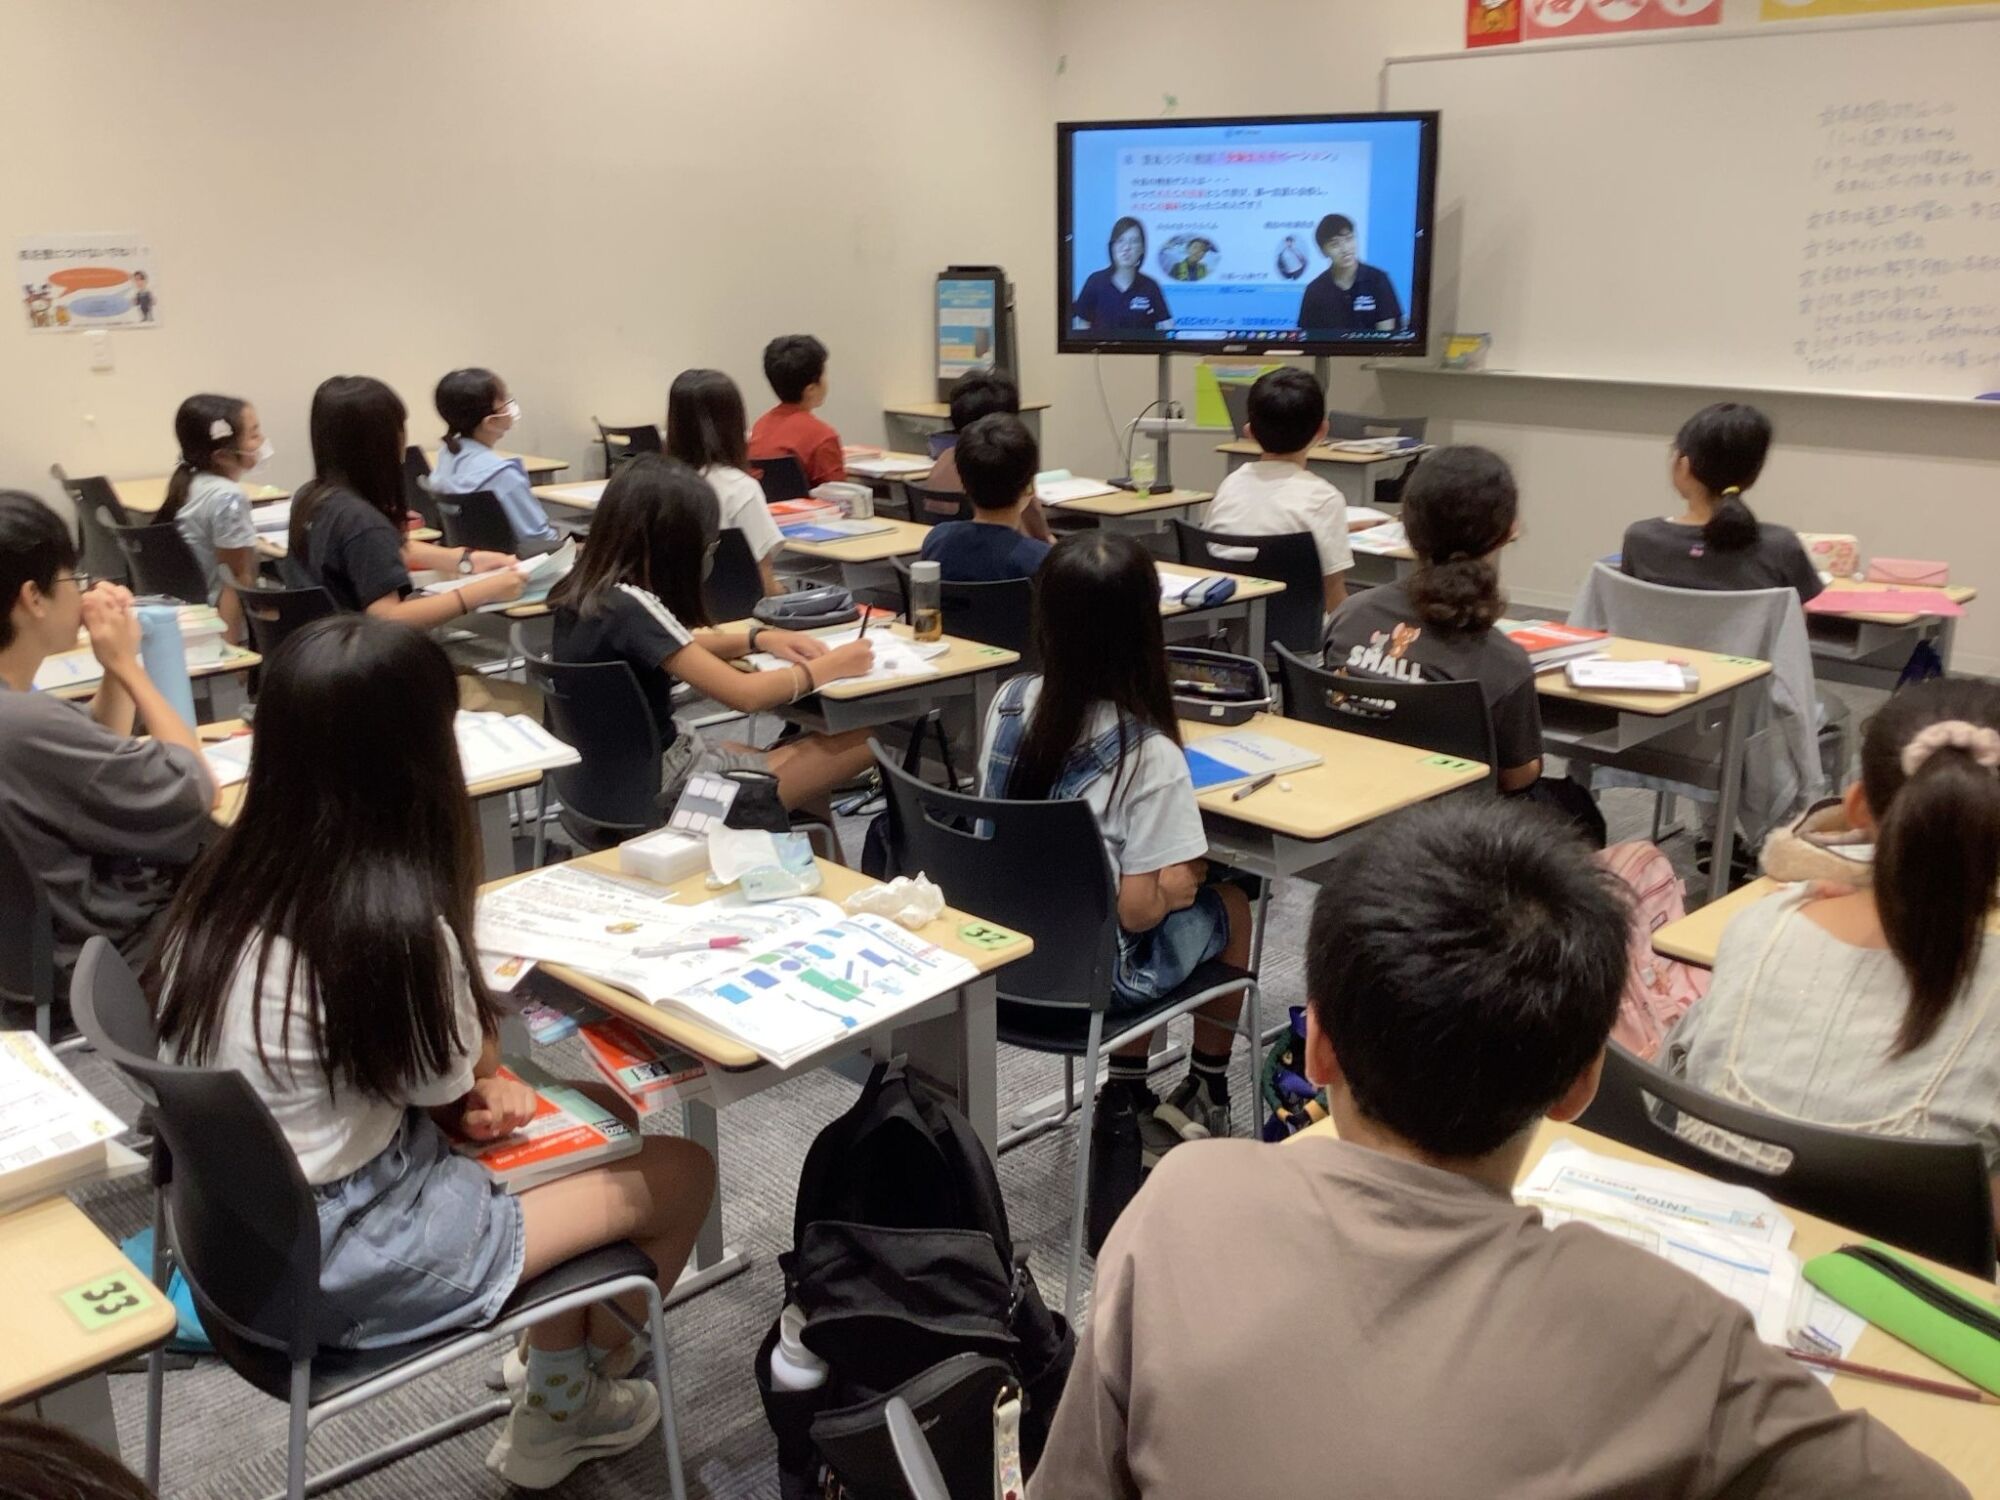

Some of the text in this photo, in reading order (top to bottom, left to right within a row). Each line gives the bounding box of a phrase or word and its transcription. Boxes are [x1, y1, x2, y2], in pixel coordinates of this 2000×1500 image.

[1346, 644, 1427, 683] SMALL
[965, 926, 1008, 944] 32
[1634, 1192, 1691, 1214] POINT
[81, 1281, 140, 1316] 33
